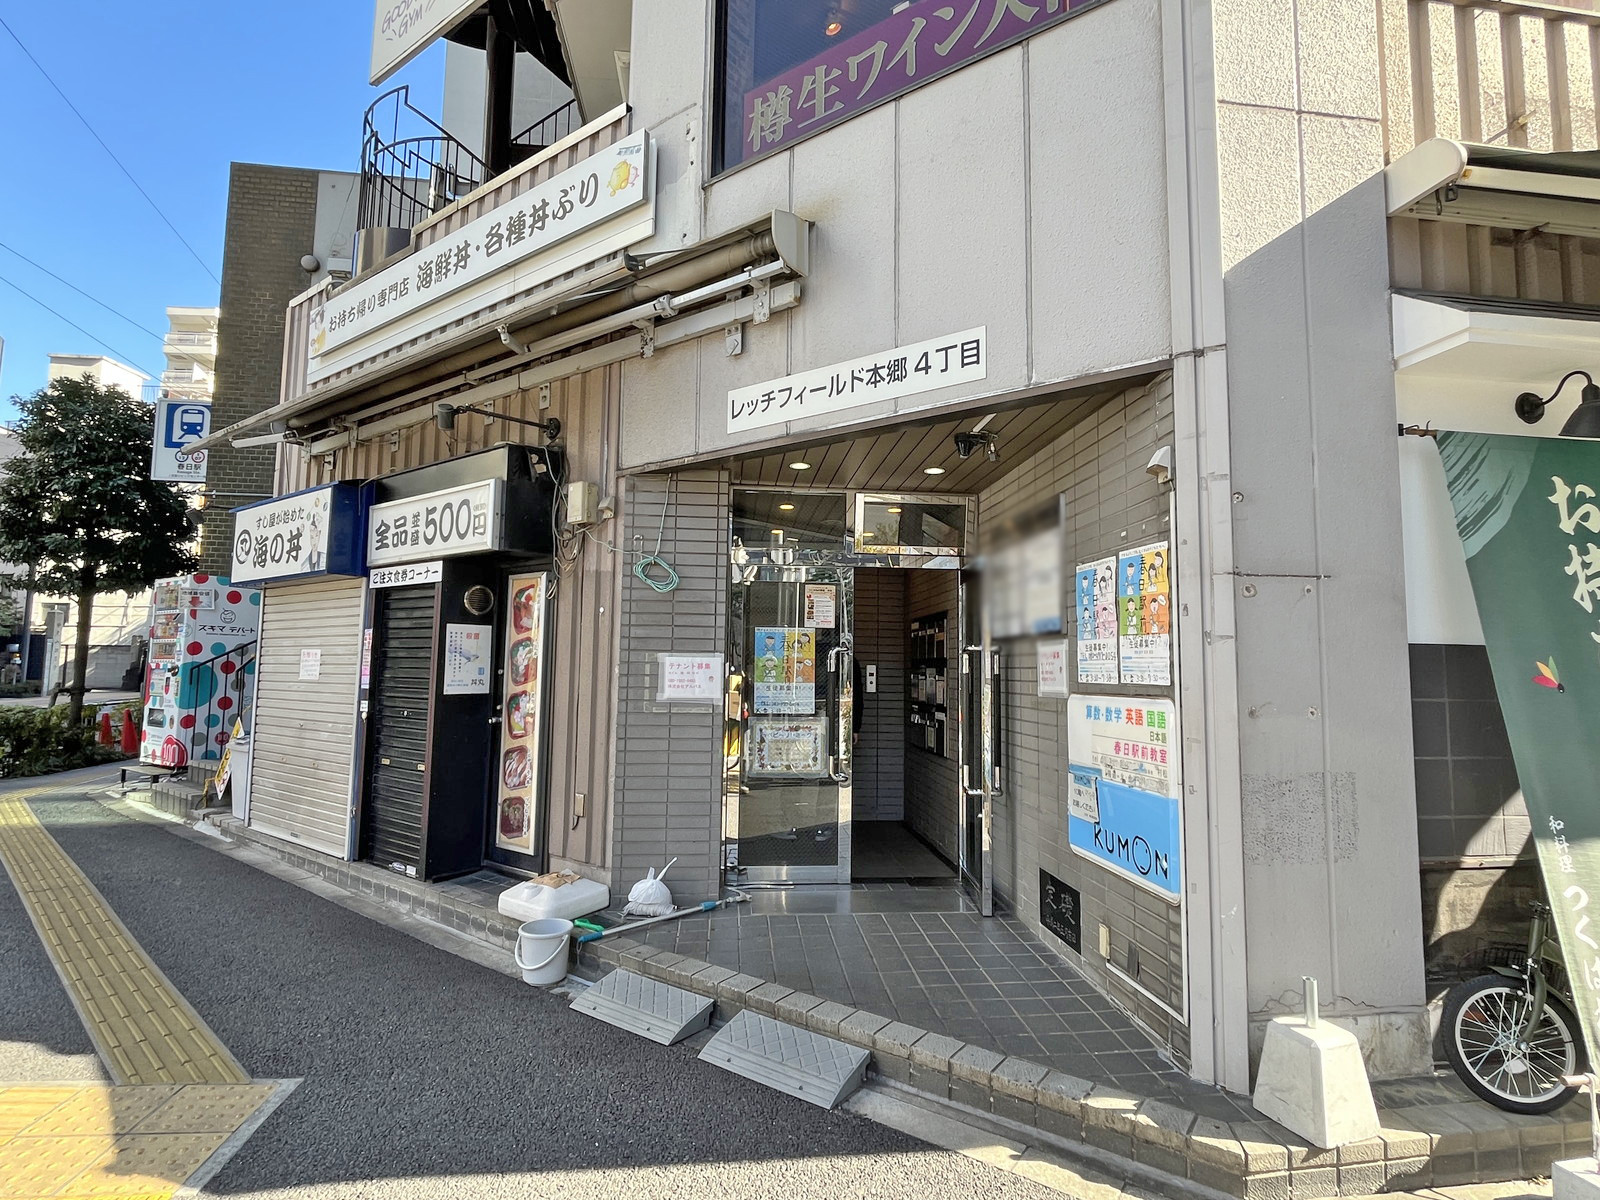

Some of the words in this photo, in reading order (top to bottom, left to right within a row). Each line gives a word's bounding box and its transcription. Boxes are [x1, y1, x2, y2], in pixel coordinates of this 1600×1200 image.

[398, 4, 423, 38] GYM
[747, 0, 1060, 152] 樽生ワイン
[329, 277, 410, 333] お持ち帰り専門店
[178, 463, 201, 471] 春日駅
[253, 527, 303, 568] 海の丼
[373, 566, 439, 584] ご注文食券コーナー
[198, 624, 227, 632] スキマ
[229, 626, 256, 634] デパート
[669, 662, 711, 670] テナント募集
[1086, 704, 1123, 724] 算数・数学
[1125, 707, 1144, 727] 英語
[1146, 710, 1167, 730] 国語
[1149, 730, 1168, 745] 日本語
[1114, 741, 1168, 764] 春日駅前教室
[1094, 822, 1169, 881] KUMON
